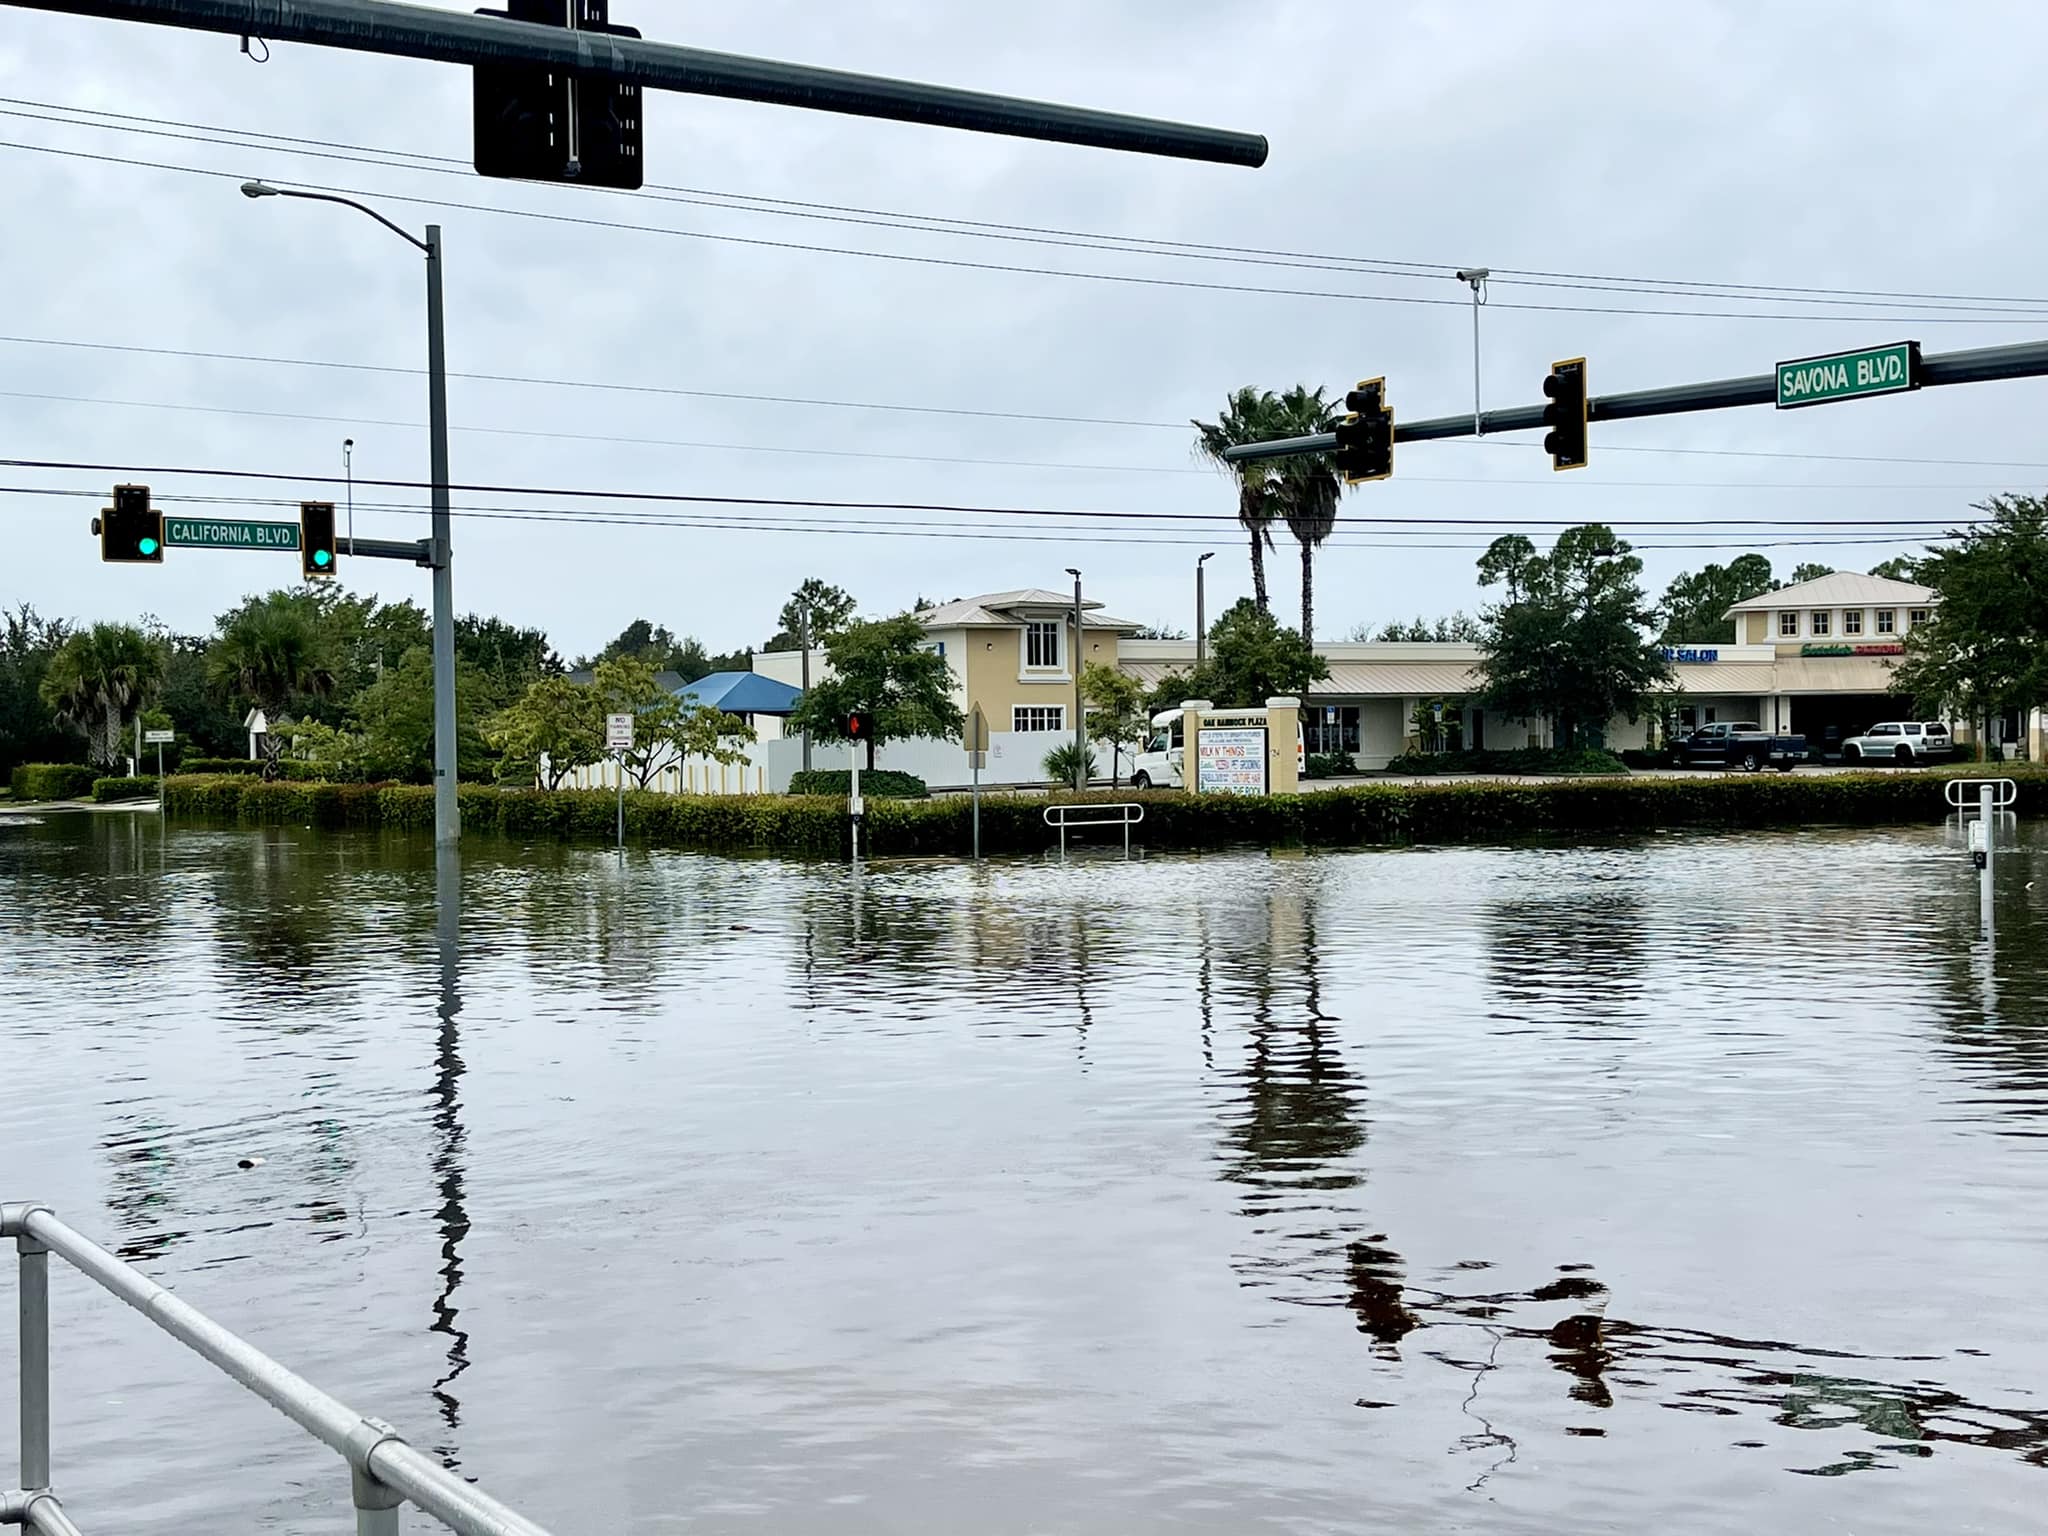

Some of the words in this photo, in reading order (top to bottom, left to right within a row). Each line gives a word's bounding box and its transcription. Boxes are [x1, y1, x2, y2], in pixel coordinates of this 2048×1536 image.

[1783, 363, 1849, 397] SAVONA
[1857, 355, 1904, 385] BLVD.
[172, 524, 251, 542] CALIFORNIA
[256, 527, 293, 544] BLVD.
[1677, 649, 1718, 662] SALON
[1203, 718, 1215, 726] OAK
[1248, 717, 1267, 726] PLAZA
[1200, 747, 1213, 756] MILK
[1222, 746, 1245, 756] THINGS
